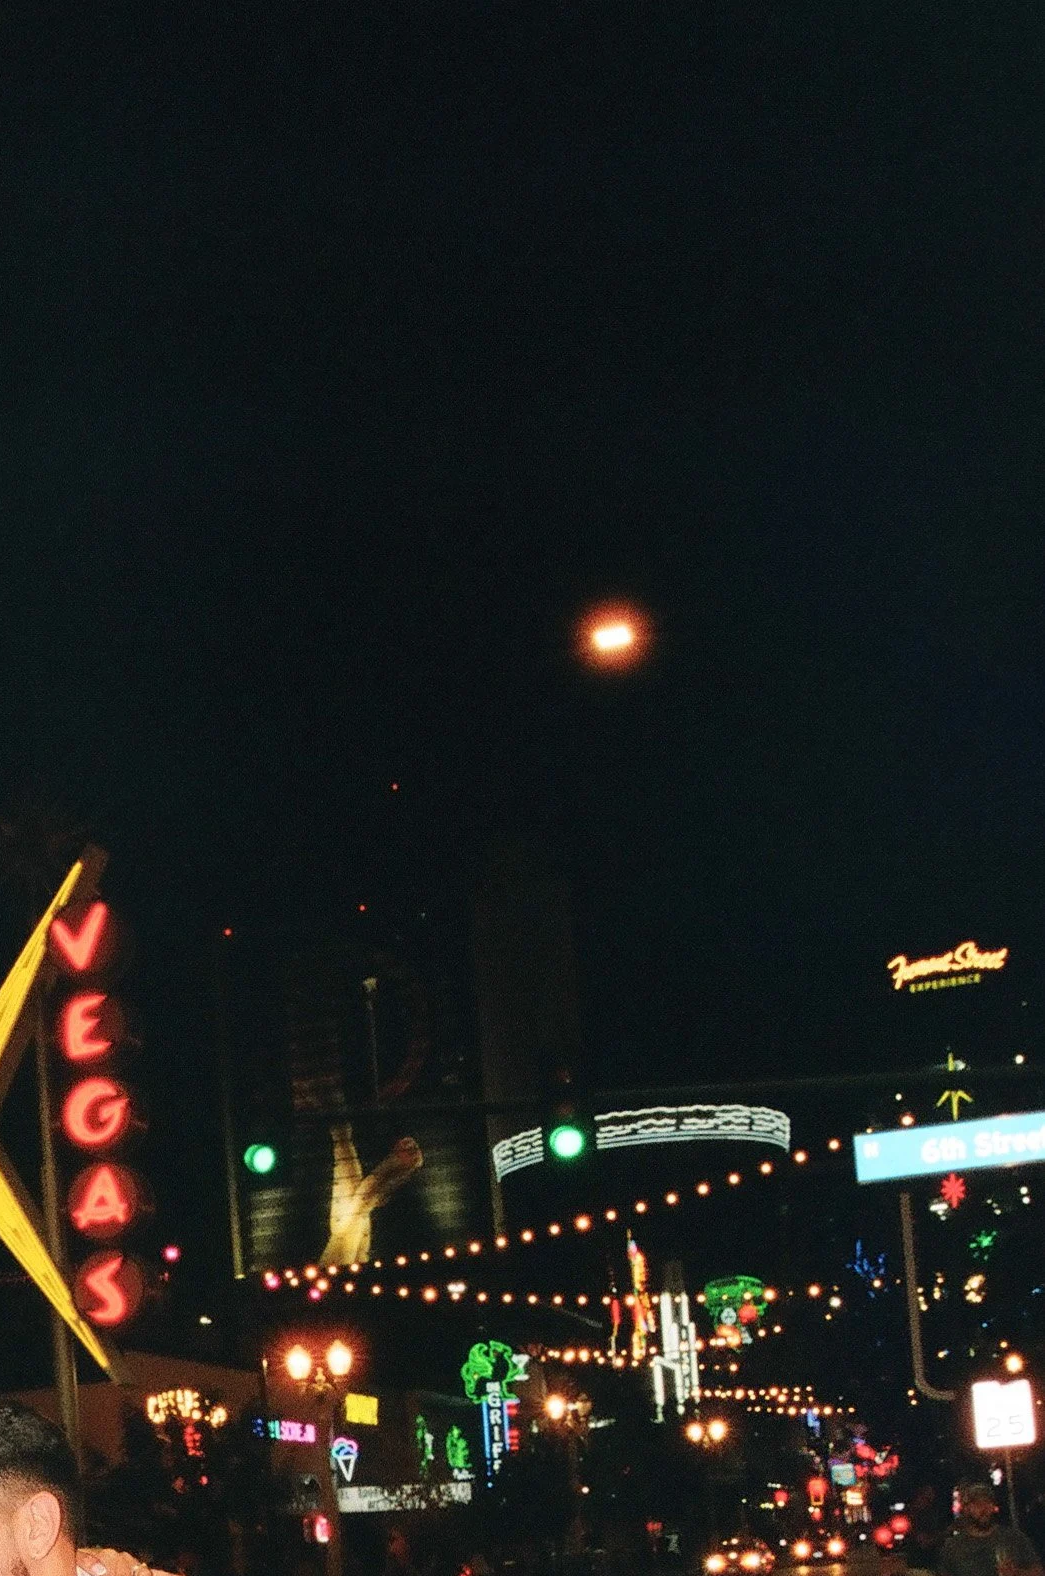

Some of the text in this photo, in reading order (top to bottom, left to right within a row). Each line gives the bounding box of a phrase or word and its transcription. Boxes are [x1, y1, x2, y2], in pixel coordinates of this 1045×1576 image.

[51, 901, 129, 1326] VEGAS
[921, 1136, 967, 1165] 6th
[986, 1414, 1025, 1438] 25
